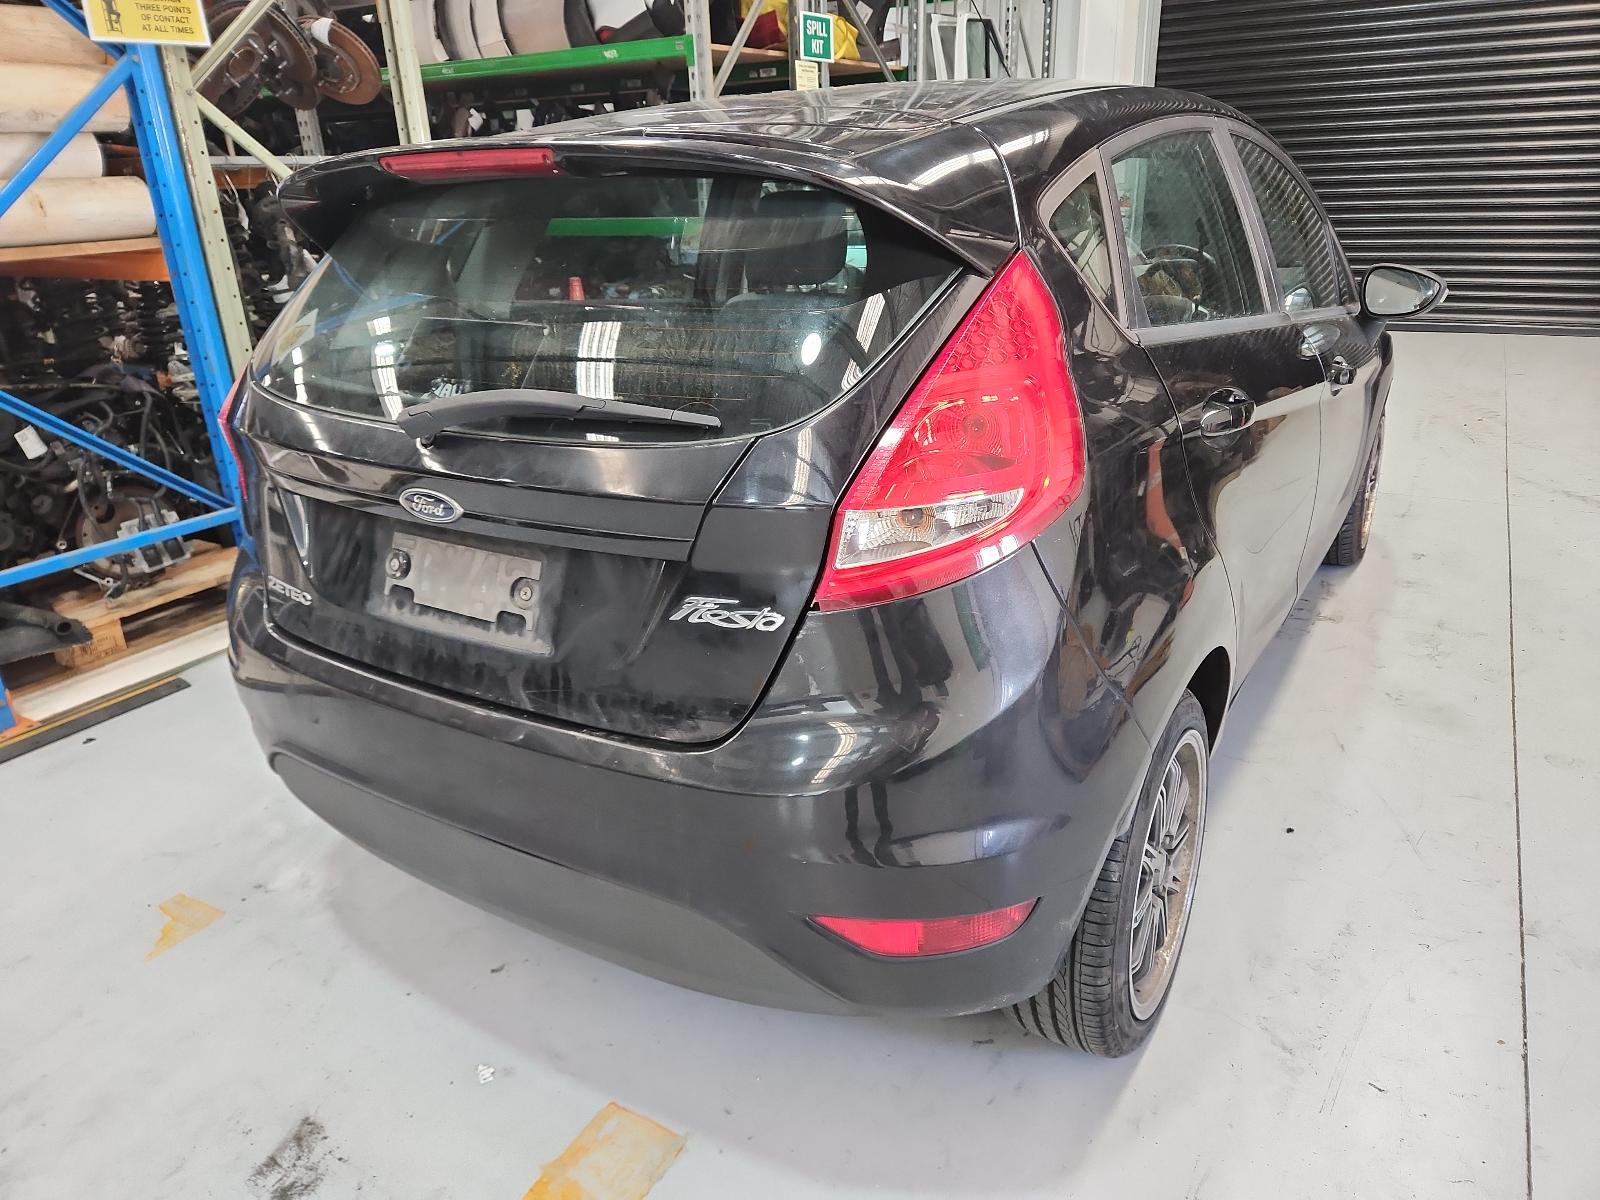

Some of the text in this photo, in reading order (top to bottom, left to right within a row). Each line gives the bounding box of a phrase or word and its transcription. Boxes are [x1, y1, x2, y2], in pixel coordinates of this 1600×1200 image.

[134, 2, 192, 14] THREE POINTS
[141, 13, 190, 24] OF CONTACT
[142, 24, 194, 34] AT ALL TIMES
[806, 19, 828, 38] SPILL
[811, 38, 824, 55] KIT
[412, 494, 445, 517] Ford
[268, 575, 313, 606] ZETEC
[669, 596, 785, 631] Fiesta
